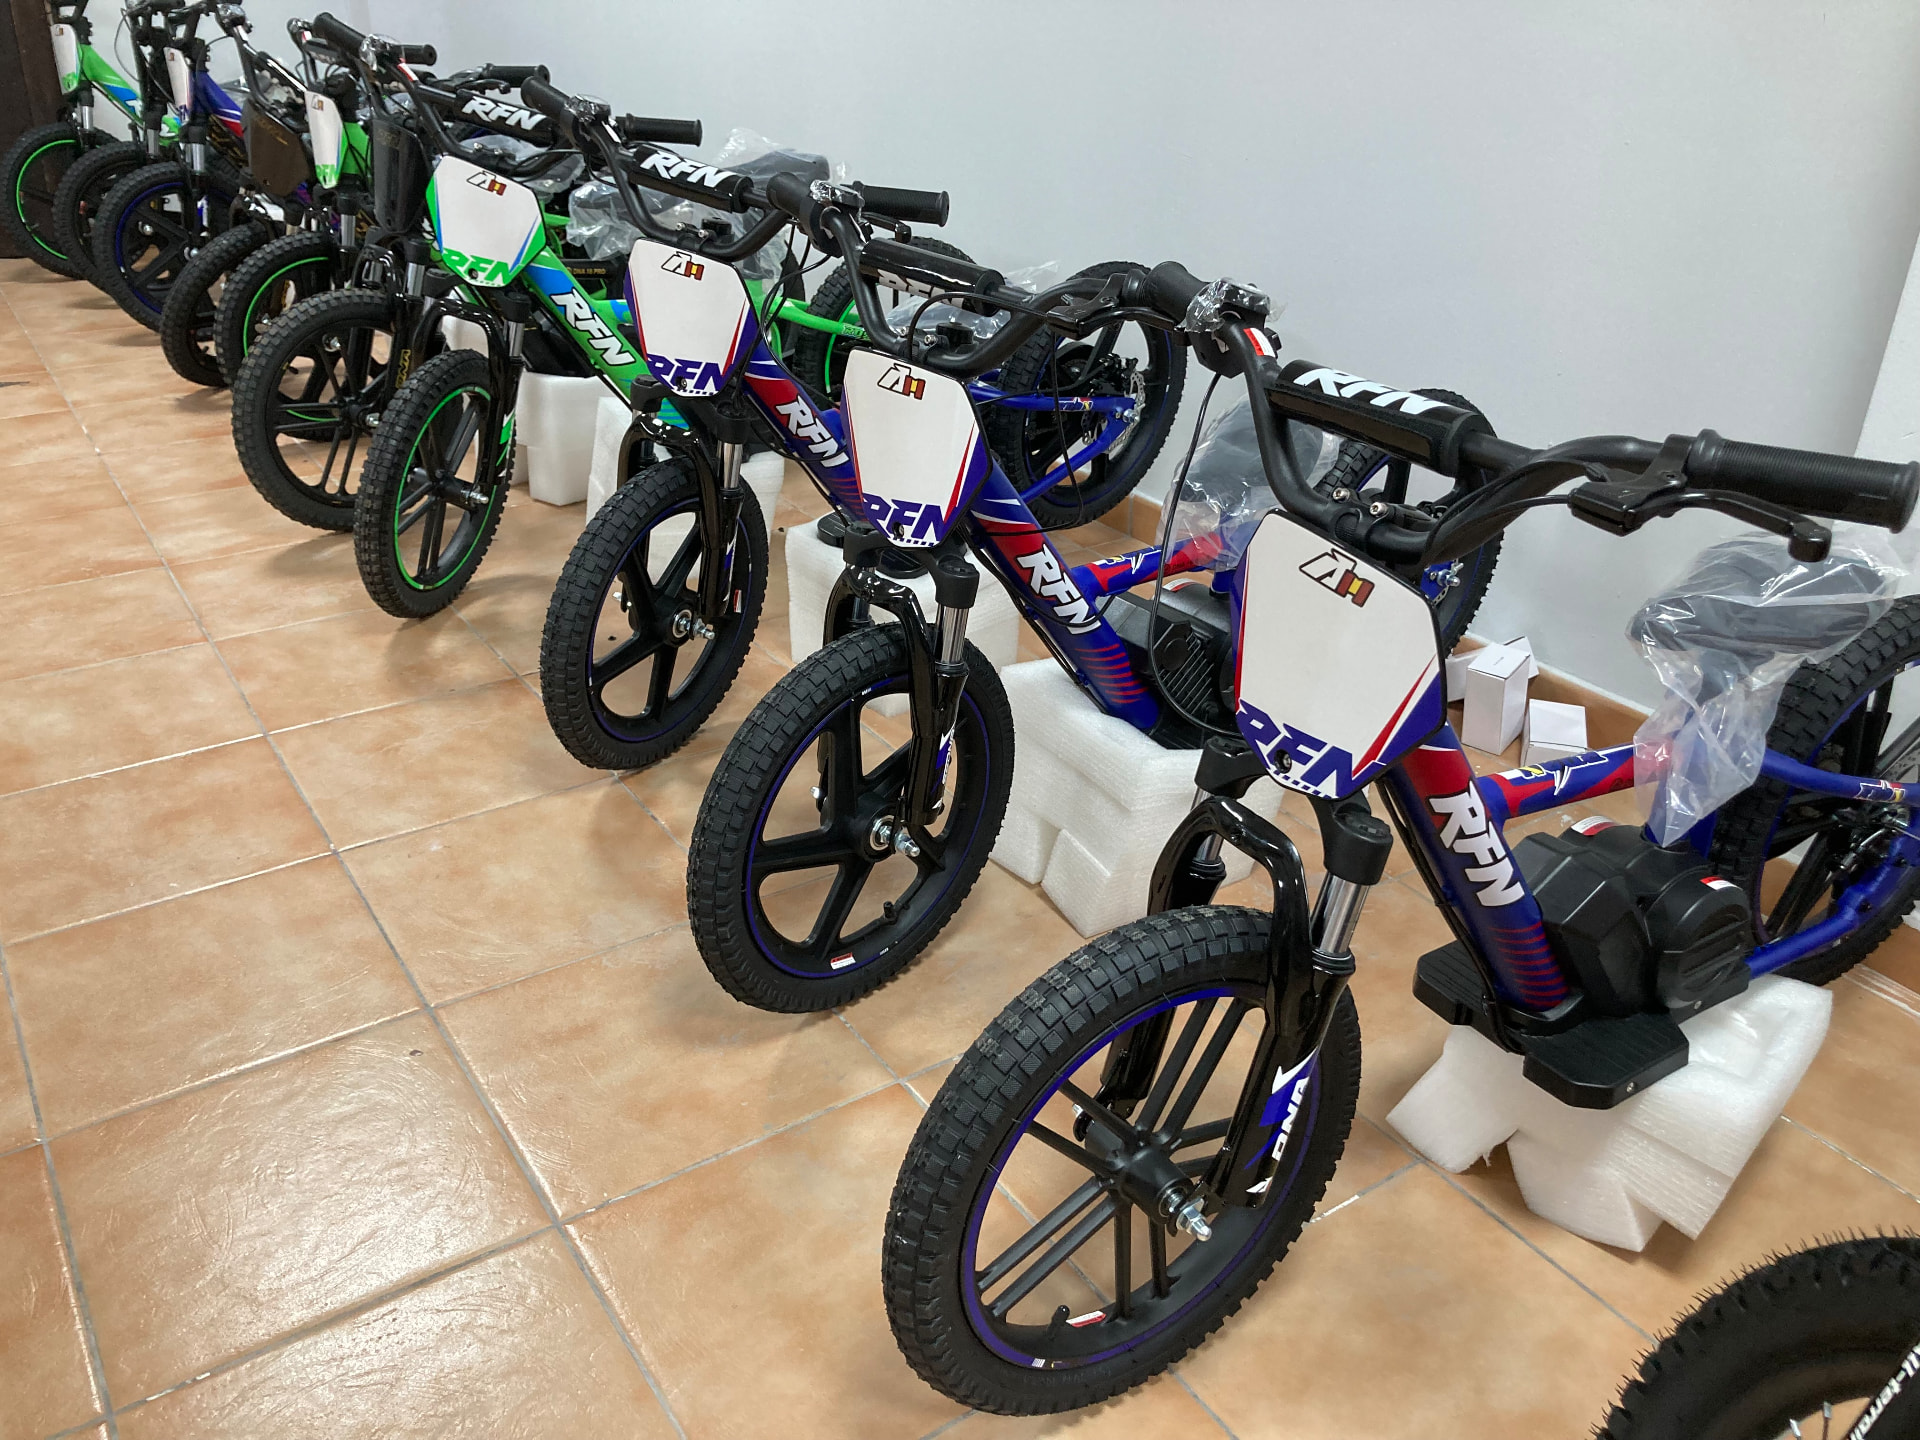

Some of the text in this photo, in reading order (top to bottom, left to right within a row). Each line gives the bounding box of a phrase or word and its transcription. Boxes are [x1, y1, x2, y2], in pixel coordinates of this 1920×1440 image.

[462, 95, 547, 131] RFN
[640, 151, 737, 189] RFN
[442, 247, 516, 285] RFN
[551, 288, 636, 367] RFN
[645, 353, 727, 392] RFN
[775, 394, 850, 469] RFN
[862, 492, 949, 542] RFN
[1016, 543, 1102, 636] RFN
[1235, 698, 1363, 799] RFN
[1428, 779, 1526, 908] RFN
